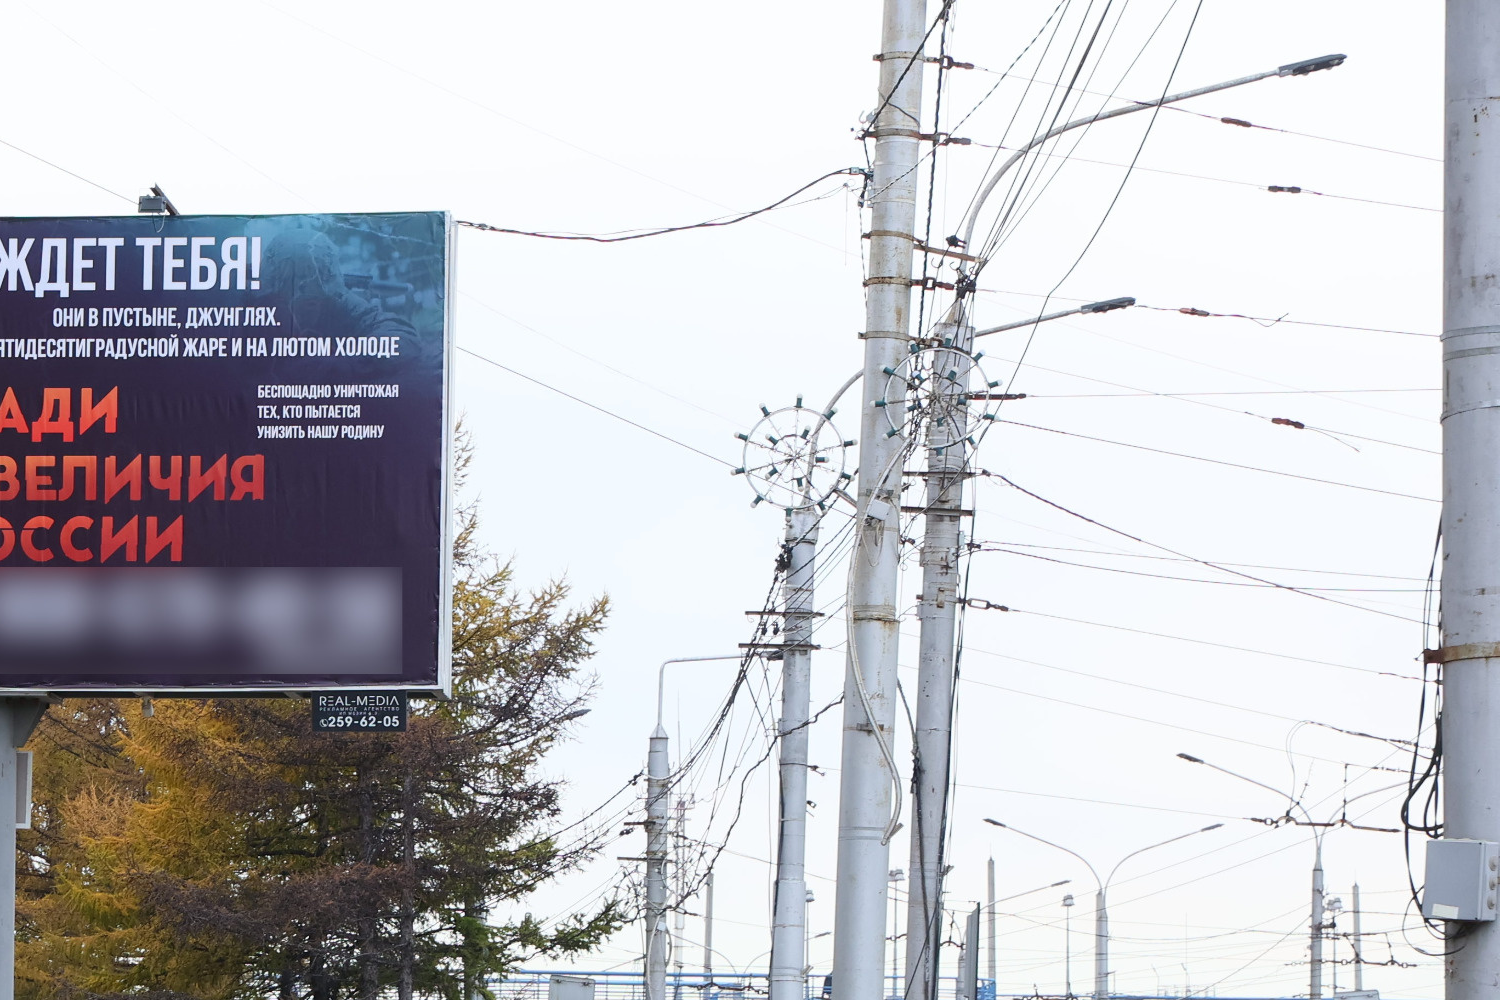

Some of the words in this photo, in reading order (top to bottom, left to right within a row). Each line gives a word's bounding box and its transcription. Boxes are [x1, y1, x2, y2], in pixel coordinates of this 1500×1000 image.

[135, 236, 262, 291] ТЕБЯ!
[52, 307, 85, 328] ОНИ
[88, 307, 99, 327] В
[102, 307, 182, 329] ПУСТЫНЕ,
[185, 306, 281, 329] ДЖУНГЛЯХ.
[182, 337, 228, 357] ЖАРЕ
[231, 337, 243, 357] И
[246, 337, 268, 357] НА
[270, 337, 331, 357] ЛЮТОМ
[334, 336, 400, 359] ХОЛОДЕ
[257, 384, 332, 400] БЕСПОЩАДНО
[333, 384, 399, 398] УНИЧТОЖАЯ
[256, 405, 280, 420] ТЕХ,
[282, 405, 303, 419] КТО
[304, 404, 361, 419] ПЫТАЕТСЯ
[257, 425, 306, 439] УНИЗИТЬ
[307, 425, 340, 439] НАШУ
[341, 424, 385, 440] РОДИНУ
[319, 695, 399, 706] REAL-MEDIA
[328, 716, 400, 728] 259-62-05
